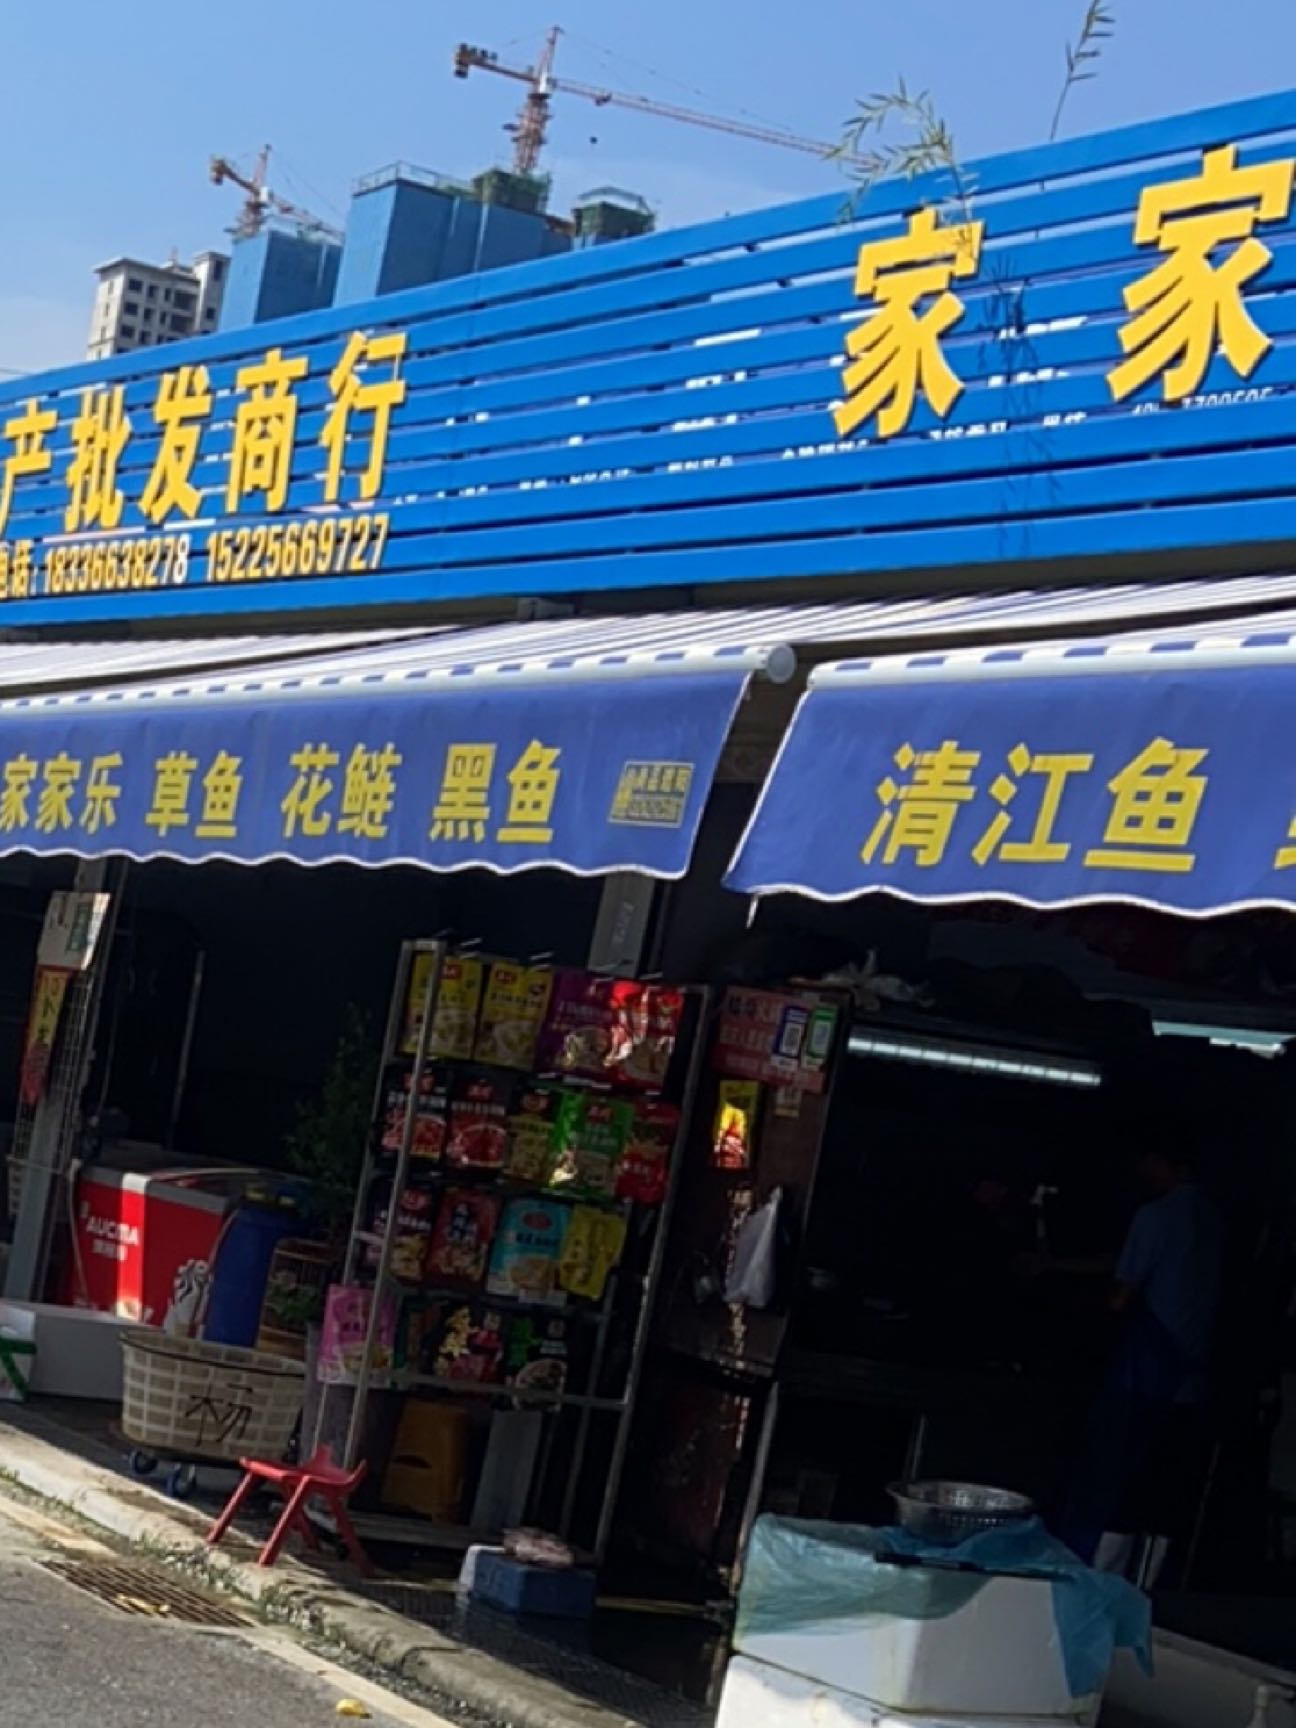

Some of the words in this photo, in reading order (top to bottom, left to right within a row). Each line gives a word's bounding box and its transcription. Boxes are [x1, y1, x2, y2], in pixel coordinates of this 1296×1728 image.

[206, 512, 390, 582] 15225669727
[145, 752, 244, 838] 草鱼
[281, 742, 402, 838] 花鲢
[429, 739, 561, 843] 黑鱼
[861, 737, 1210, 873] 清江鱼
